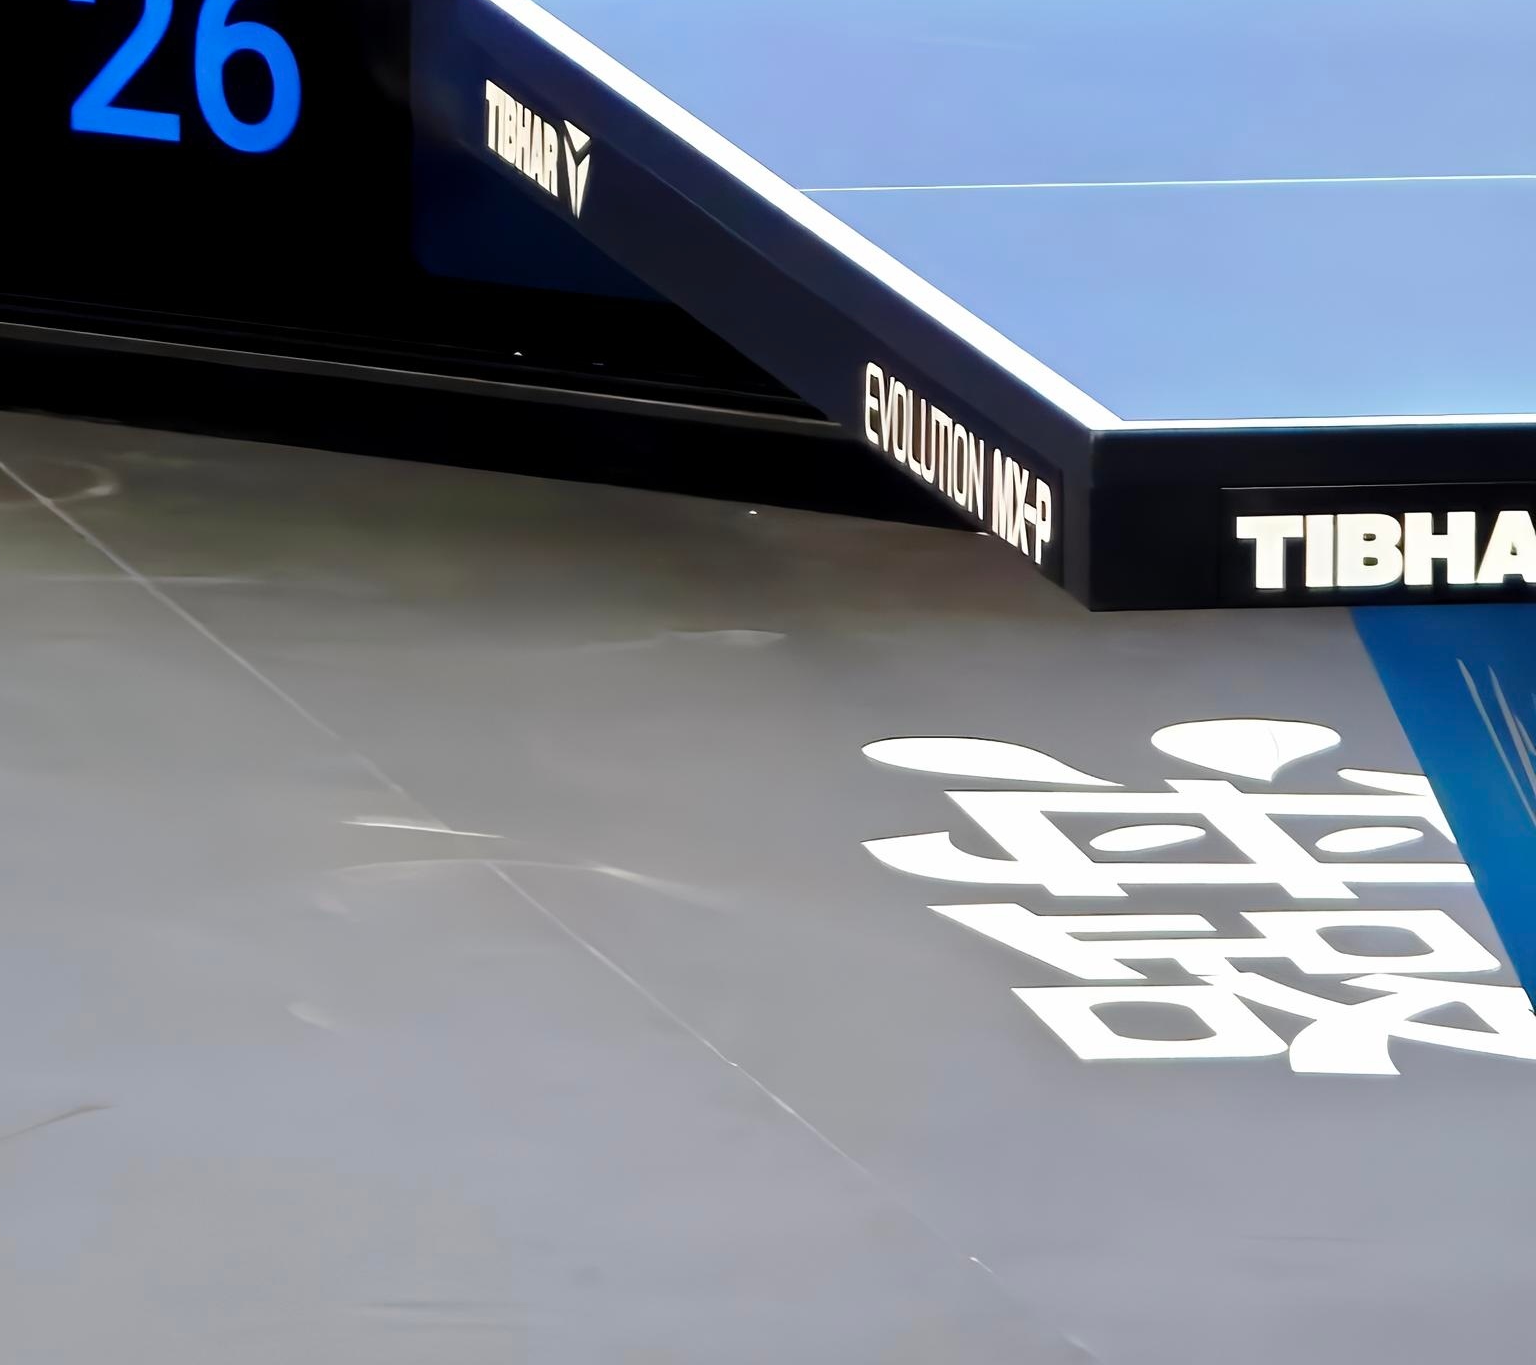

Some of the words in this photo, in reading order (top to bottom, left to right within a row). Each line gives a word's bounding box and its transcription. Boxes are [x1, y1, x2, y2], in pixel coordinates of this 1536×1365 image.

[485, 79, 559, 198] TIBHAR
[865, 361, 985, 521] EVOLUTION
[992, 448, 1052, 565] MX-P
[1236, 510, 1536, 589] TIBHA
